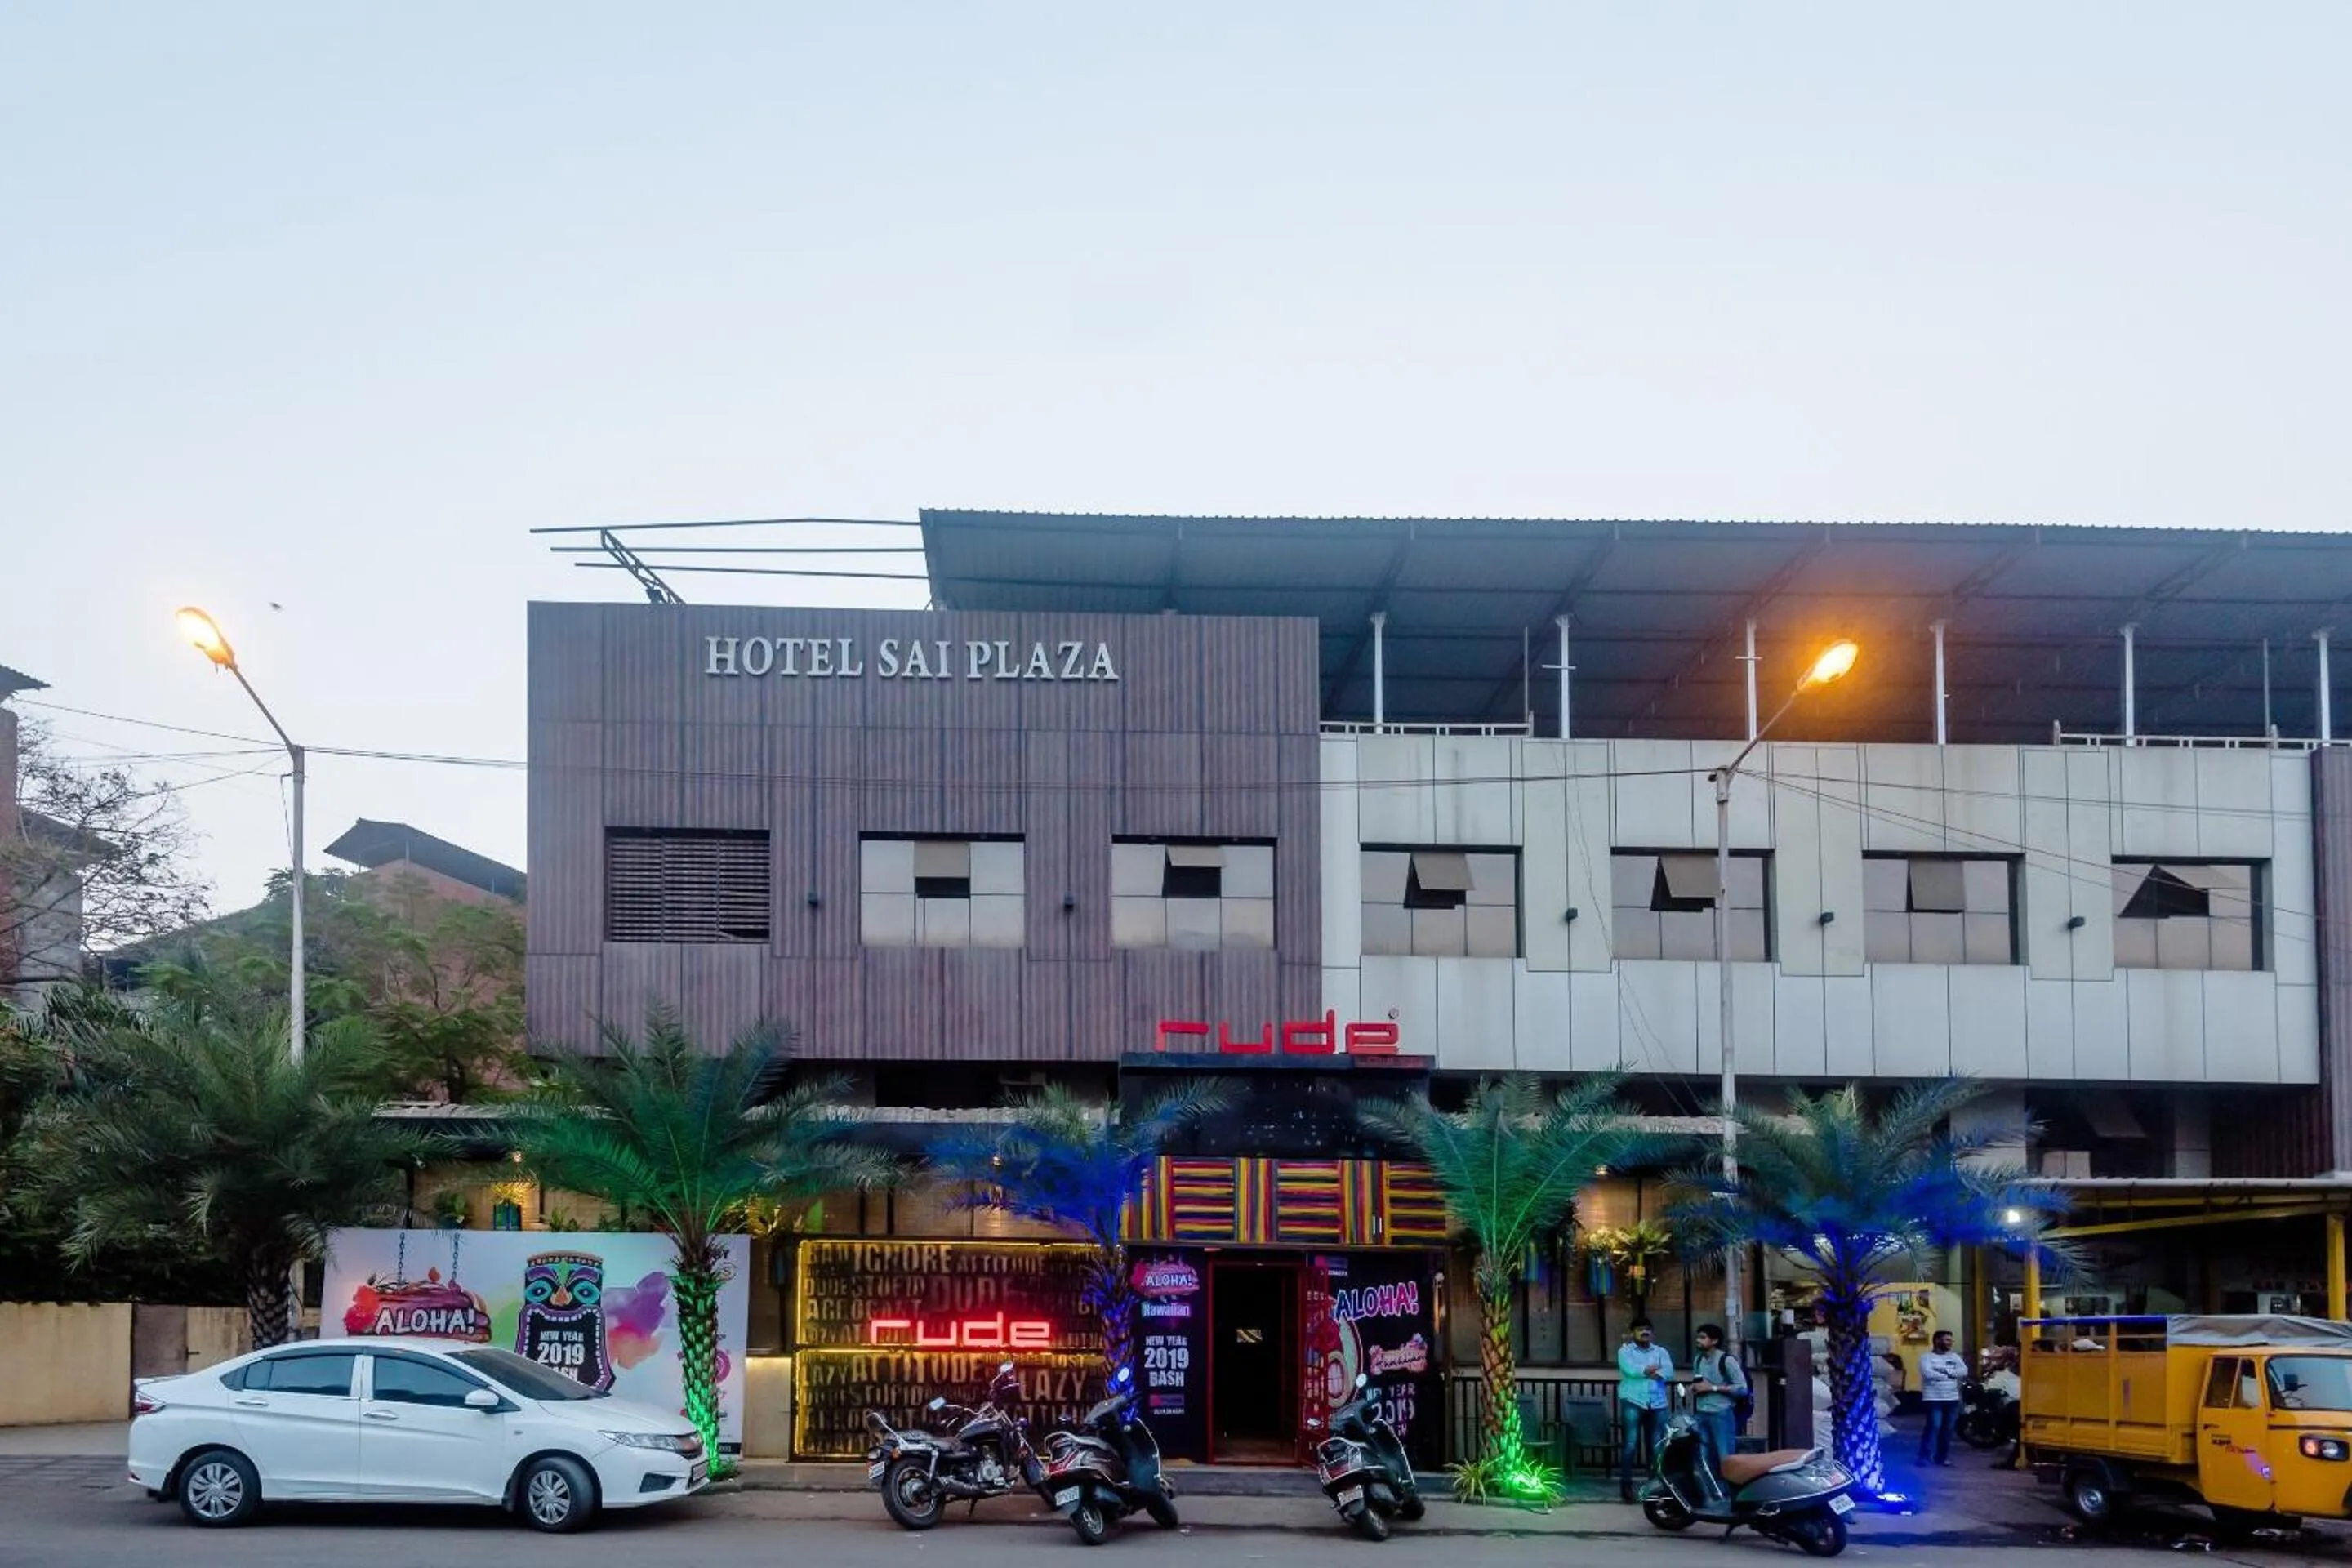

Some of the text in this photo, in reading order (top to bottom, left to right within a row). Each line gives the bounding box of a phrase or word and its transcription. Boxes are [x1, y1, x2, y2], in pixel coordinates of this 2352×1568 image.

[705, 636, 1120, 680] HOTEL SAI PLAZA
[1154, 1009, 1399, 1054] rude
[1145, 1274, 1192, 1286] ALOHA!
[1334, 1281, 1419, 1322] ALOHA!
[376, 1307, 475, 1336] ALOHA!
[871, 1310, 1050, 1348] rude
[540, 1330, 584, 1343] NEW YEAR
[1145, 1335, 1187, 1346] NEW YEAR
[537, 1342, 586, 1365] 2019
[1144, 1346, 1190, 1370] 2019
[1018, 1369, 1087, 1401] LAZY
[1149, 1370, 1185, 1387] BASH
